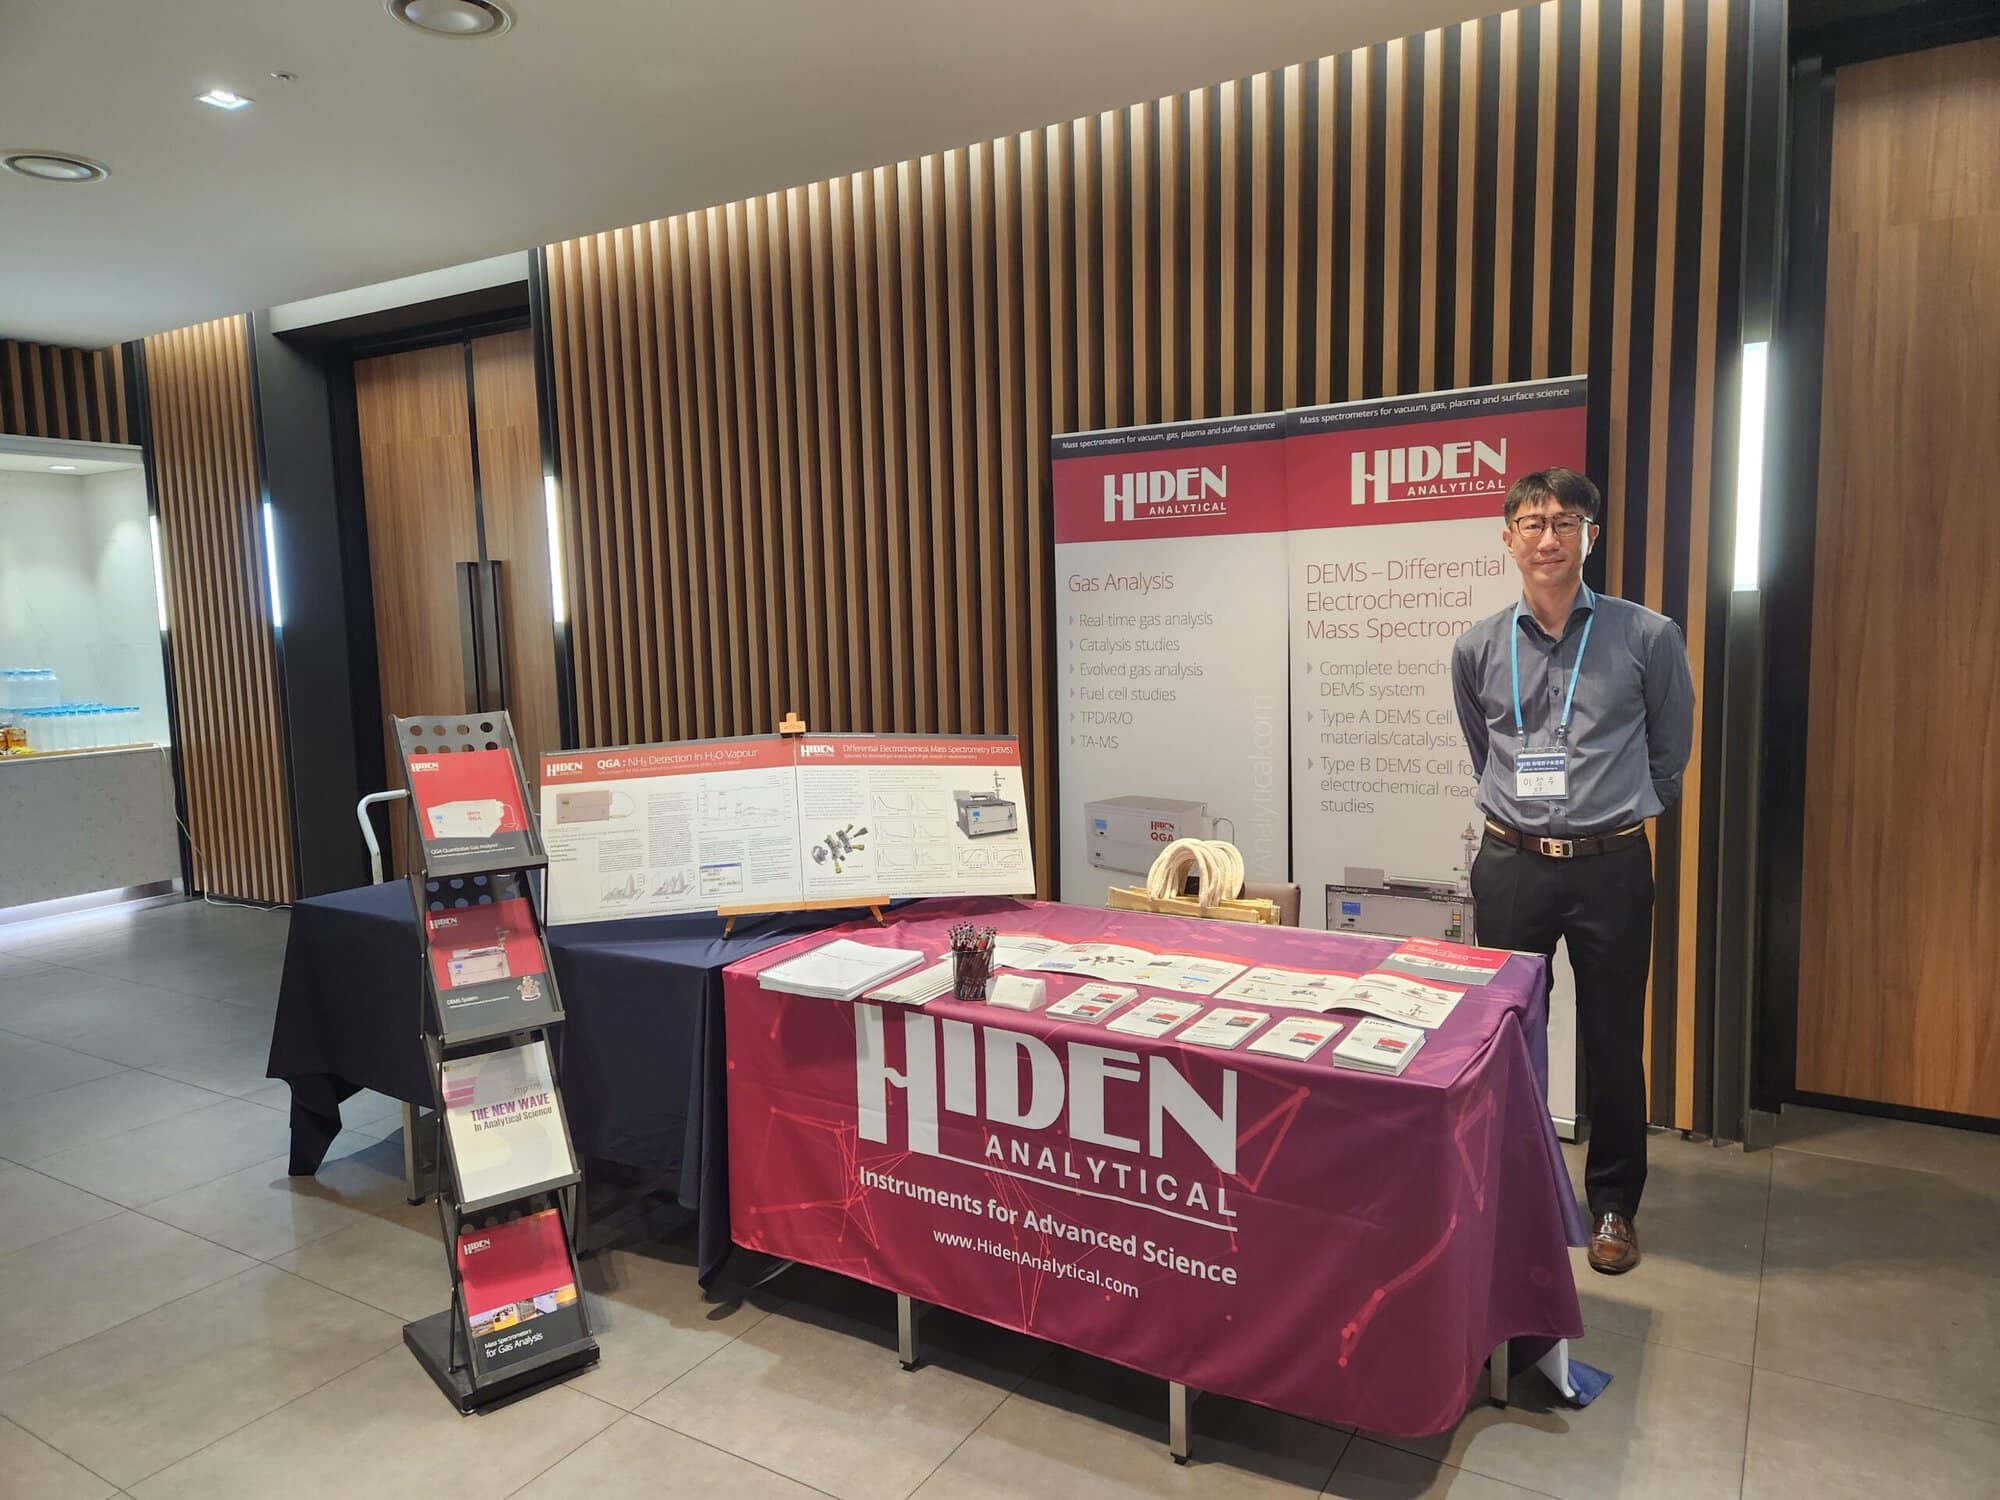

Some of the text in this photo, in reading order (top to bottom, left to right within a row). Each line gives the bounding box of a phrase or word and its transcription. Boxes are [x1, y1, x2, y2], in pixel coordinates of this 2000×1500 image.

[1300, 388, 1570, 424] Mass spectrometers for vacuum, gas, plasma and surface science
[1062, 421, 1276, 449] Mass spectrometers for vacuum, gas, plasma and surface science
[1351, 438, 1507, 505] HIDEN
[1103, 465, 1227, 522] HIDEN
[1407, 479, 1506, 496] ANALYTICAL
[1149, 502, 1227, 515] ANALYTICAL
[1306, 562, 1368, 584] DEMS
[1387, 553, 1506, 581] Differential
[1068, 571, 1175, 595] Gas Analysis
[1306, 585, 1472, 612] Electrochemical
[1079, 611, 1214, 630] Real-time gas analysis
[1306, 617, 1474, 644] Mass Spectrom
[1079, 637, 1181, 655] Catalysis studies
[1080, 662, 1204, 680] Evolved gas analysis
[1319, 660, 1453, 679] Complete bench-
[1080, 687, 1177, 701] Fuel cell studies
[1320, 682, 1425, 700] DEMS system
[1080, 711, 1133, 725] TPD/R/O
[1320, 709, 1452, 727] Type A DEMS Cell
[930, 745, 947, 753] Mass
[1080, 735, 1120, 749] TA-MS
[1320, 731, 1457, 750] materials/catalysis
[597, 758, 620, 770] QGA
[649, 753, 692, 765] Detection
[725, 749, 758, 760] Vapour
[800, 744, 834, 757] HIDEN
[546, 761, 583, 777] HIDEN
[1320, 756, 1474, 775] Type B DEMS Cell fo
[1320, 778, 1478, 799] electrochemical reac
[1320, 799, 1375, 814] studies
[1151, 832, 1174, 842] QGA
[854, 1002, 1238, 1175] HIDEN
[470, 1092, 550, 1122] THE NEW WAVE
[484, 1112, 522, 1130] Analytical
[523, 1106, 552, 1121] Science
[985, 1135, 1238, 1218] ANALYTICAL
[858, 1166, 1238, 1286] Instruments for Advanced Science
[933, 1229, 1139, 1299] www.HidenAnalytical.com
[486, 1333, 544, 1358] for Gas Analysis
